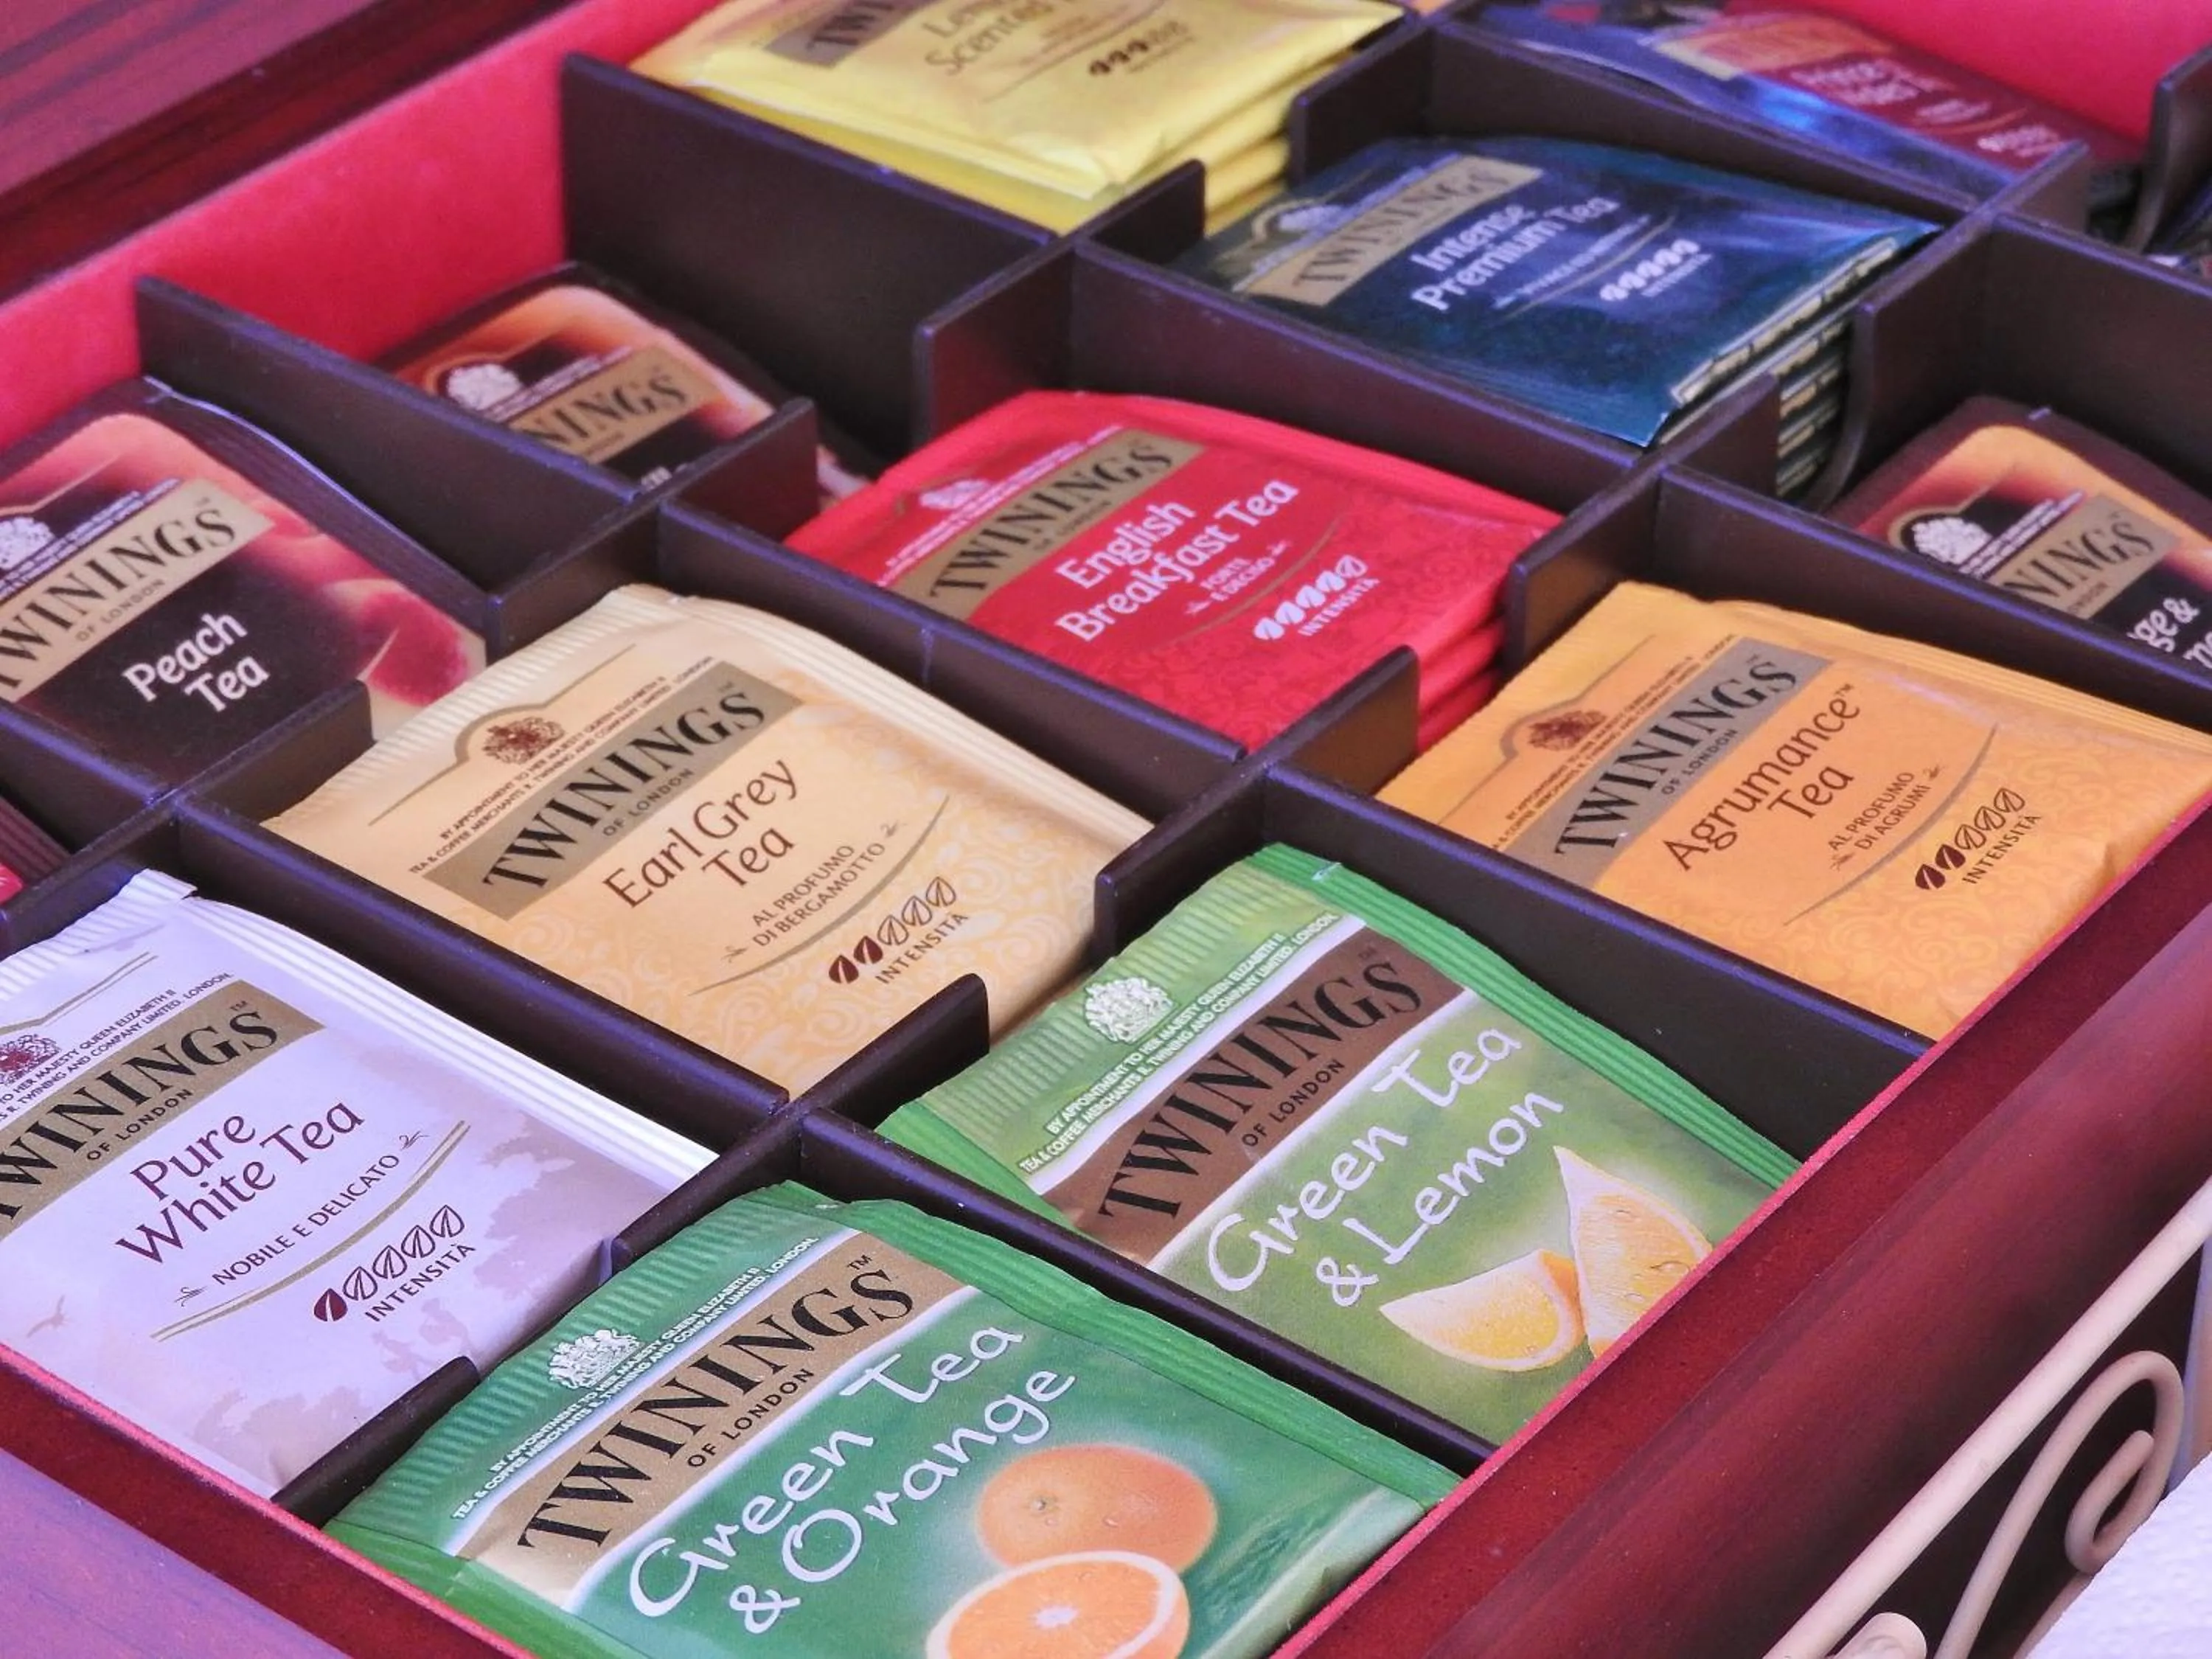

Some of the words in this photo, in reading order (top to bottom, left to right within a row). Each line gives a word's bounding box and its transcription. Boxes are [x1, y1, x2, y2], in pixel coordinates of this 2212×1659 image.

[1294, 170, 1509, 286] TWININGS
[1410, 203, 1537, 271] Intense
[1410, 220, 1568, 310] Premium
[1543, 198, 1621, 223] Tea
[521, 372, 686, 442] NINGS
[931, 445, 1172, 597] TWININGS
[1055, 500, 1195, 588] English
[1055, 525, 1239, 641] Breakfast
[1214, 480, 1300, 526] Tea
[2003, 521, 2154, 598] NINGS
[100, 580, 164, 623] LONDON
[122, 613, 247, 702] Peach
[184, 654, 269, 712] Tea
[483, 692, 765, 888] TWININGS
[603, 818, 627, 836] OF
[629, 768, 694, 817] LONDON
[1554, 661, 1797, 855] TWININGS
[1661, 778, 1680, 796] OF
[1682, 728, 1738, 776] LONDON
[1663, 698, 1860, 871] Agrumance
[1767, 766, 1854, 818] Tea
[602, 827, 703, 908] Earl
[693, 759, 797, 839] Grey
[1828, 838, 1851, 851] AL
[1845, 772, 1914, 833] PROFUMO
[1854, 832, 1878, 850] DI
[1874, 784, 1931, 835] AGRUMI
[701, 828, 796, 886] Tea
[752, 911, 776, 927] AL
[773, 845, 855, 910] PROFUMO
[753, 929, 778, 947] DI
[775, 843, 886, 933] BERGAMOTTO
[13, 1079, 37, 1094] HER
[38, 1048, 80, 1080] MAJESTY
[79, 1026, 115, 1050] QUEEN
[115, 993, 168, 1028] ELIZABETH
[18, 1071, 67, 1106] TWINING
[67, 1056, 91, 1074] AND
[90, 1023, 142, 1057] COMPANY
[87, 1142, 111, 1161] OF
[117, 1088, 193, 1141] LONDON
[1046, 1116, 1066, 1135] BY
[1060, 1063, 1130, 1121] APPOINTMENT
[1123, 1050, 1144, 1069] TO
[1097, 961, 1422, 1220] TWININGS
[1242, 1123, 1268, 1148] OF
[1269, 1059, 1346, 1123] LONDON
[116, 1161, 276, 1263] White
[260, 1102, 365, 1165] Tea
[130, 1115, 256, 1202] Pure
[1019, 1152, 1043, 1175] TEA
[1044, 1119, 1088, 1157] COFFEE
[1208, 1126, 1408, 1292] Green
[1371, 1029, 1522, 1107] Tea
[1342, 1093, 1564, 1265] Lemon
[212, 1235, 295, 1285] NOBILE
[292, 1224, 313, 1239] E
[307, 1155, 400, 1227] DELICATO
[365, 1243, 476, 1321] INTENSITÀ
[1316, 1256, 1380, 1307] &
[517, 1269, 915, 1549] TWININGS
[686, 1442, 717, 1469] OF
[727, 1367, 815, 1441] LONDON
[453, 1497, 481, 1521] TEA
[490, 1458, 507, 1473] BY
[628, 1430, 874, 1617] Green
[839, 1327, 1025, 1403] Tea
[728, 1584, 801, 1635] &
[782, 1370, 1077, 1582] Orange
